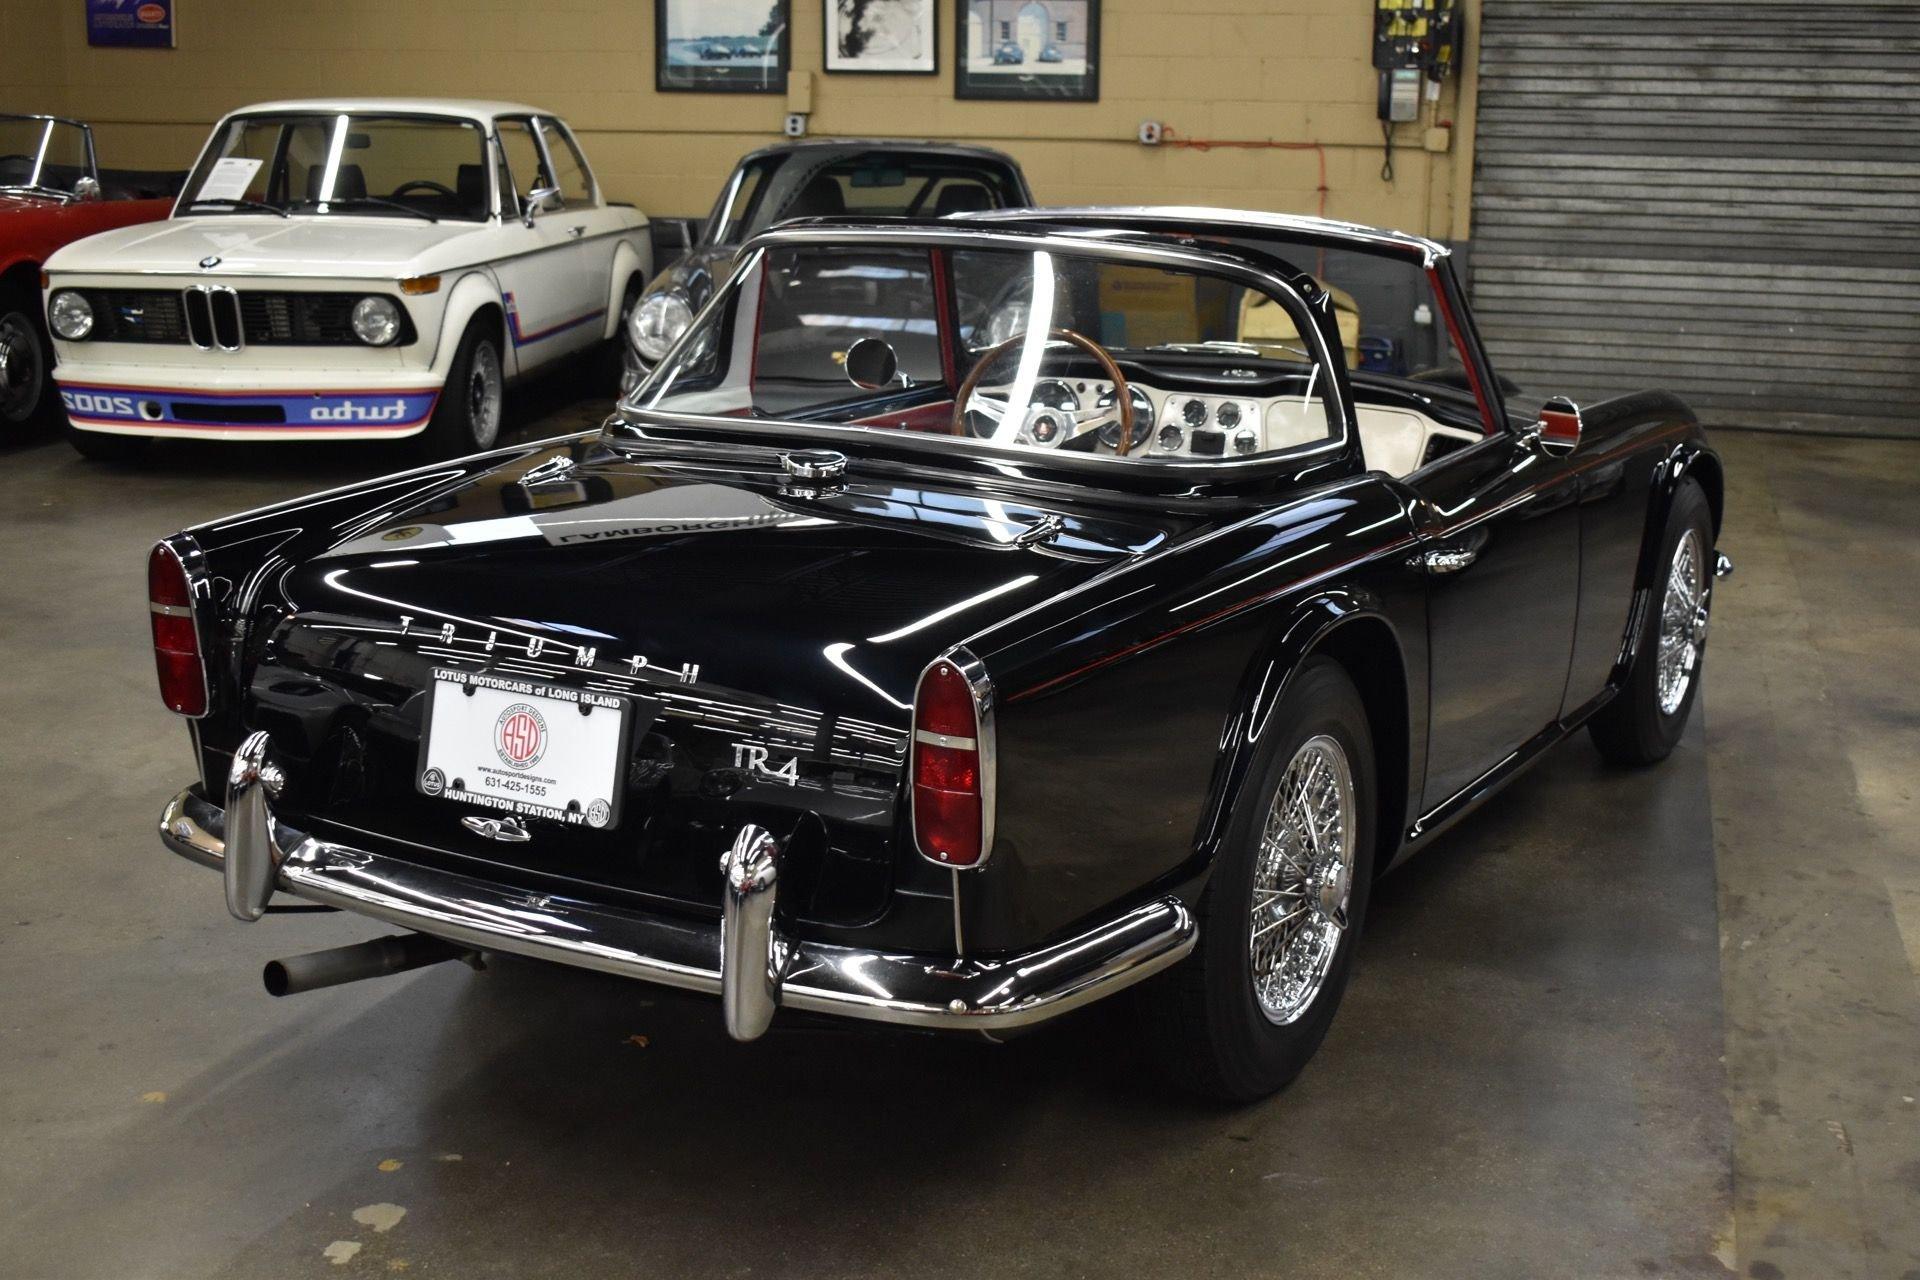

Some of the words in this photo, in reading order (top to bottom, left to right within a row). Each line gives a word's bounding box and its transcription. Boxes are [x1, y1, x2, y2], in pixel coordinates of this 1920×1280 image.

[400, 616, 699, 683] TRIUMPH
[434, 669, 467, 684] LOTUS
[469, 675, 533, 694] MOTORCARS
[535, 686, 546, 697] of
[548, 688, 578, 702] LONG
[581, 694, 620, 709] ISLAND
[477, 766, 557, 785] www.autosportdesigns.com
[485, 776, 547, 797] 631-425-1555
[444, 787, 514, 812] HUNTINGTON
[516, 800, 566, 823] STATION,
[568, 810, 586, 825] NY
